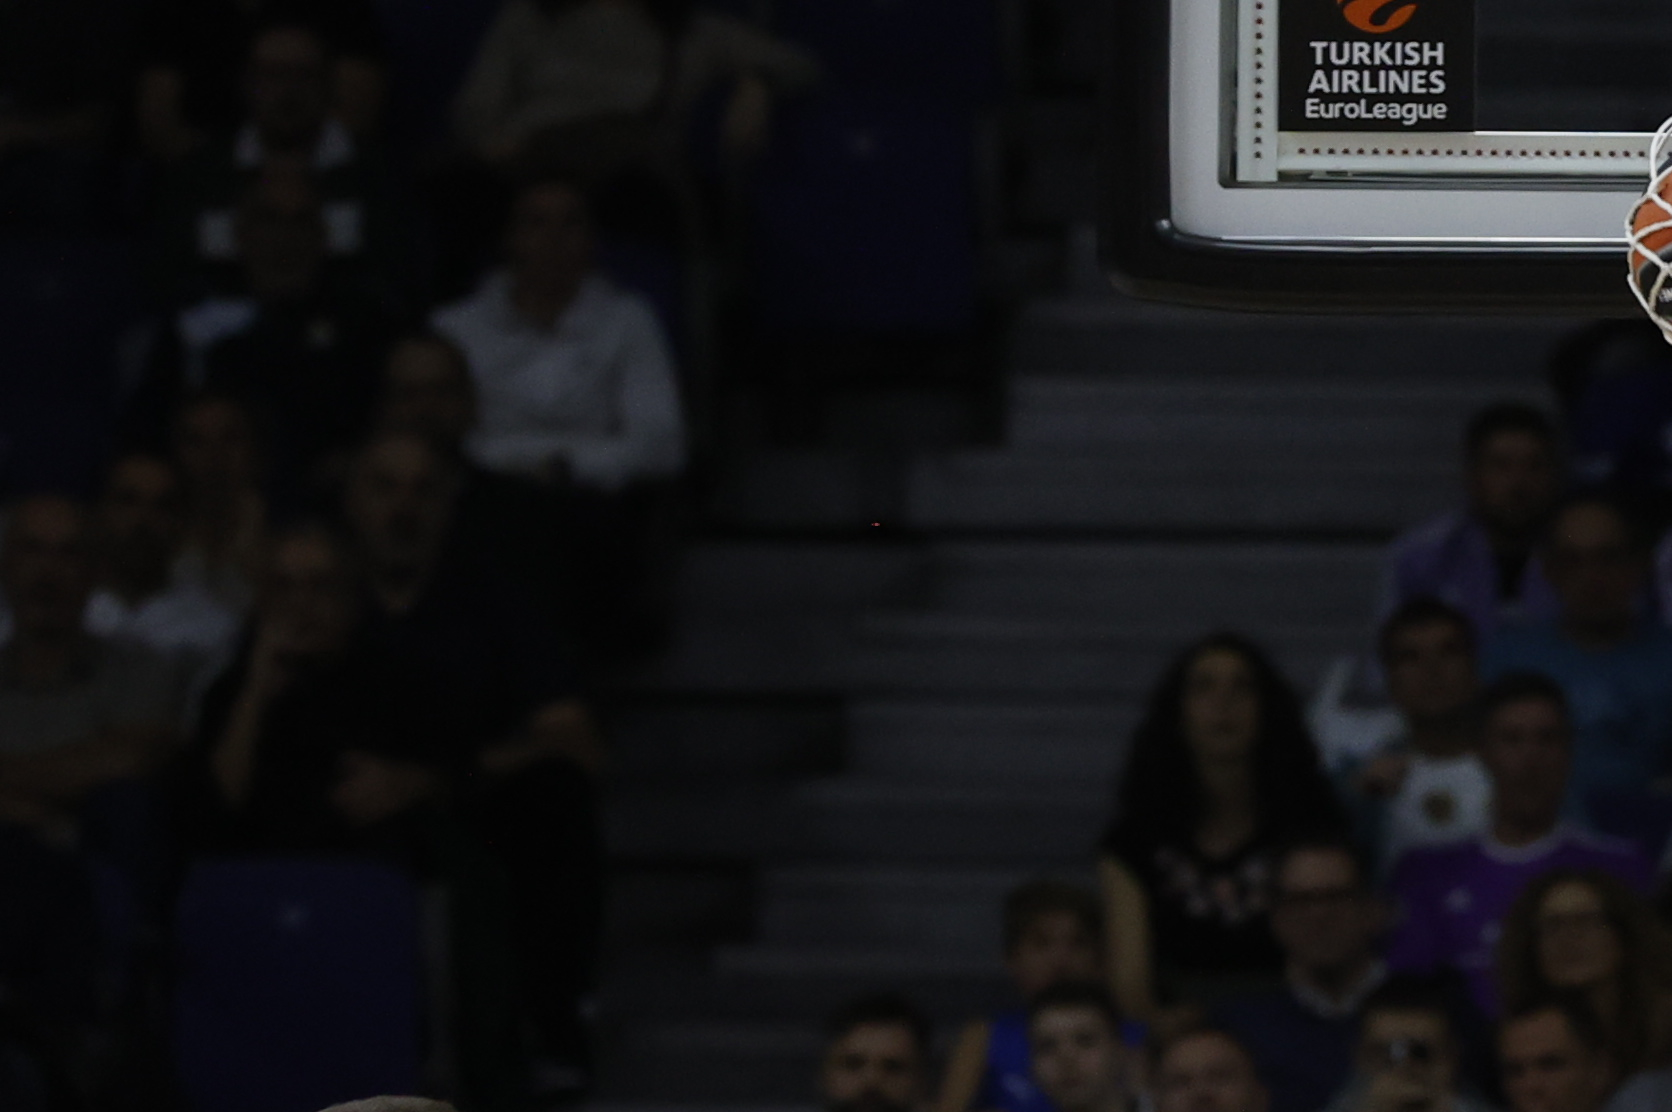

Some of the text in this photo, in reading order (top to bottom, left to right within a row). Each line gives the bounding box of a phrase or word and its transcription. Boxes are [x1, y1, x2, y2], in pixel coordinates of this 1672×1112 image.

[1309, 41, 1445, 66] TURKISH
[1307, 69, 1446, 94] AIRLINES
[1304, 98, 1448, 125] EuroLeague
